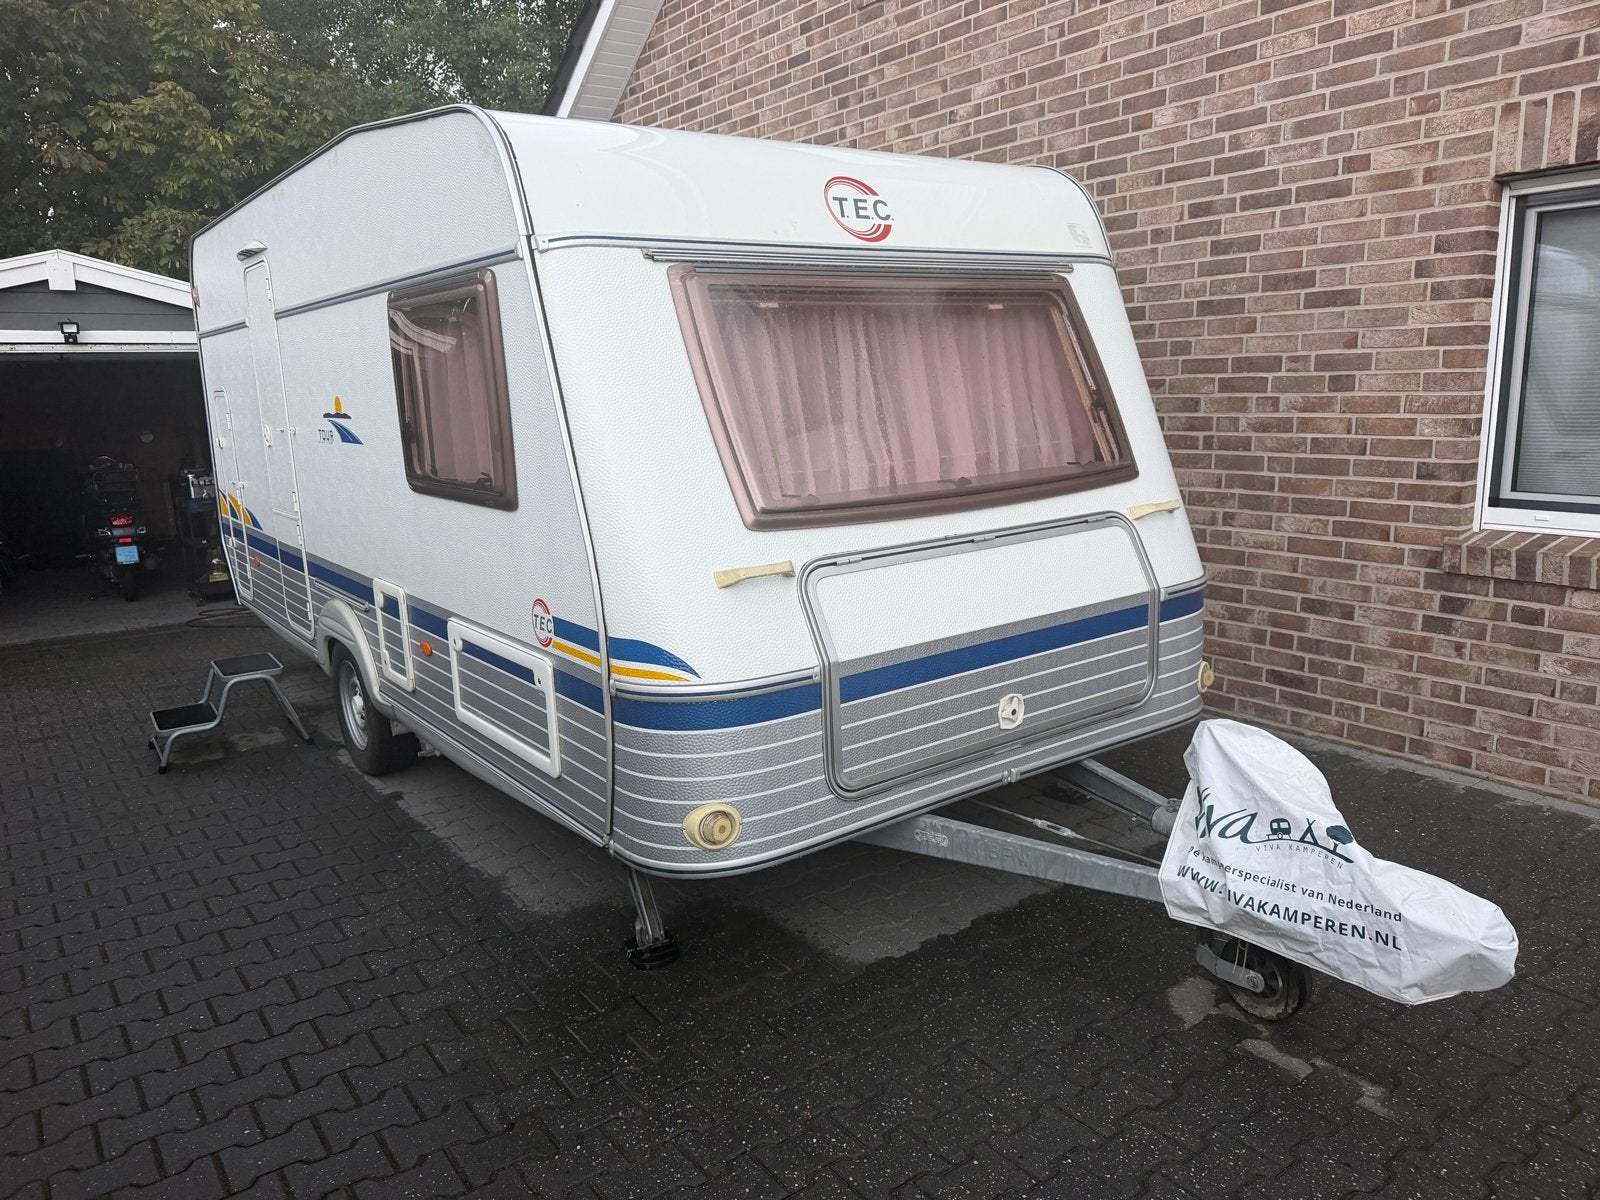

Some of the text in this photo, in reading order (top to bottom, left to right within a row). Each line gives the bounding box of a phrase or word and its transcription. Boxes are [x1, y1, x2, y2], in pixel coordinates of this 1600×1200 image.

[1255, 844, 1344, 869] VIVA KAMPEREN
[1301, 887, 1324, 901] van
[1328, 893, 1402, 922] Nederland
